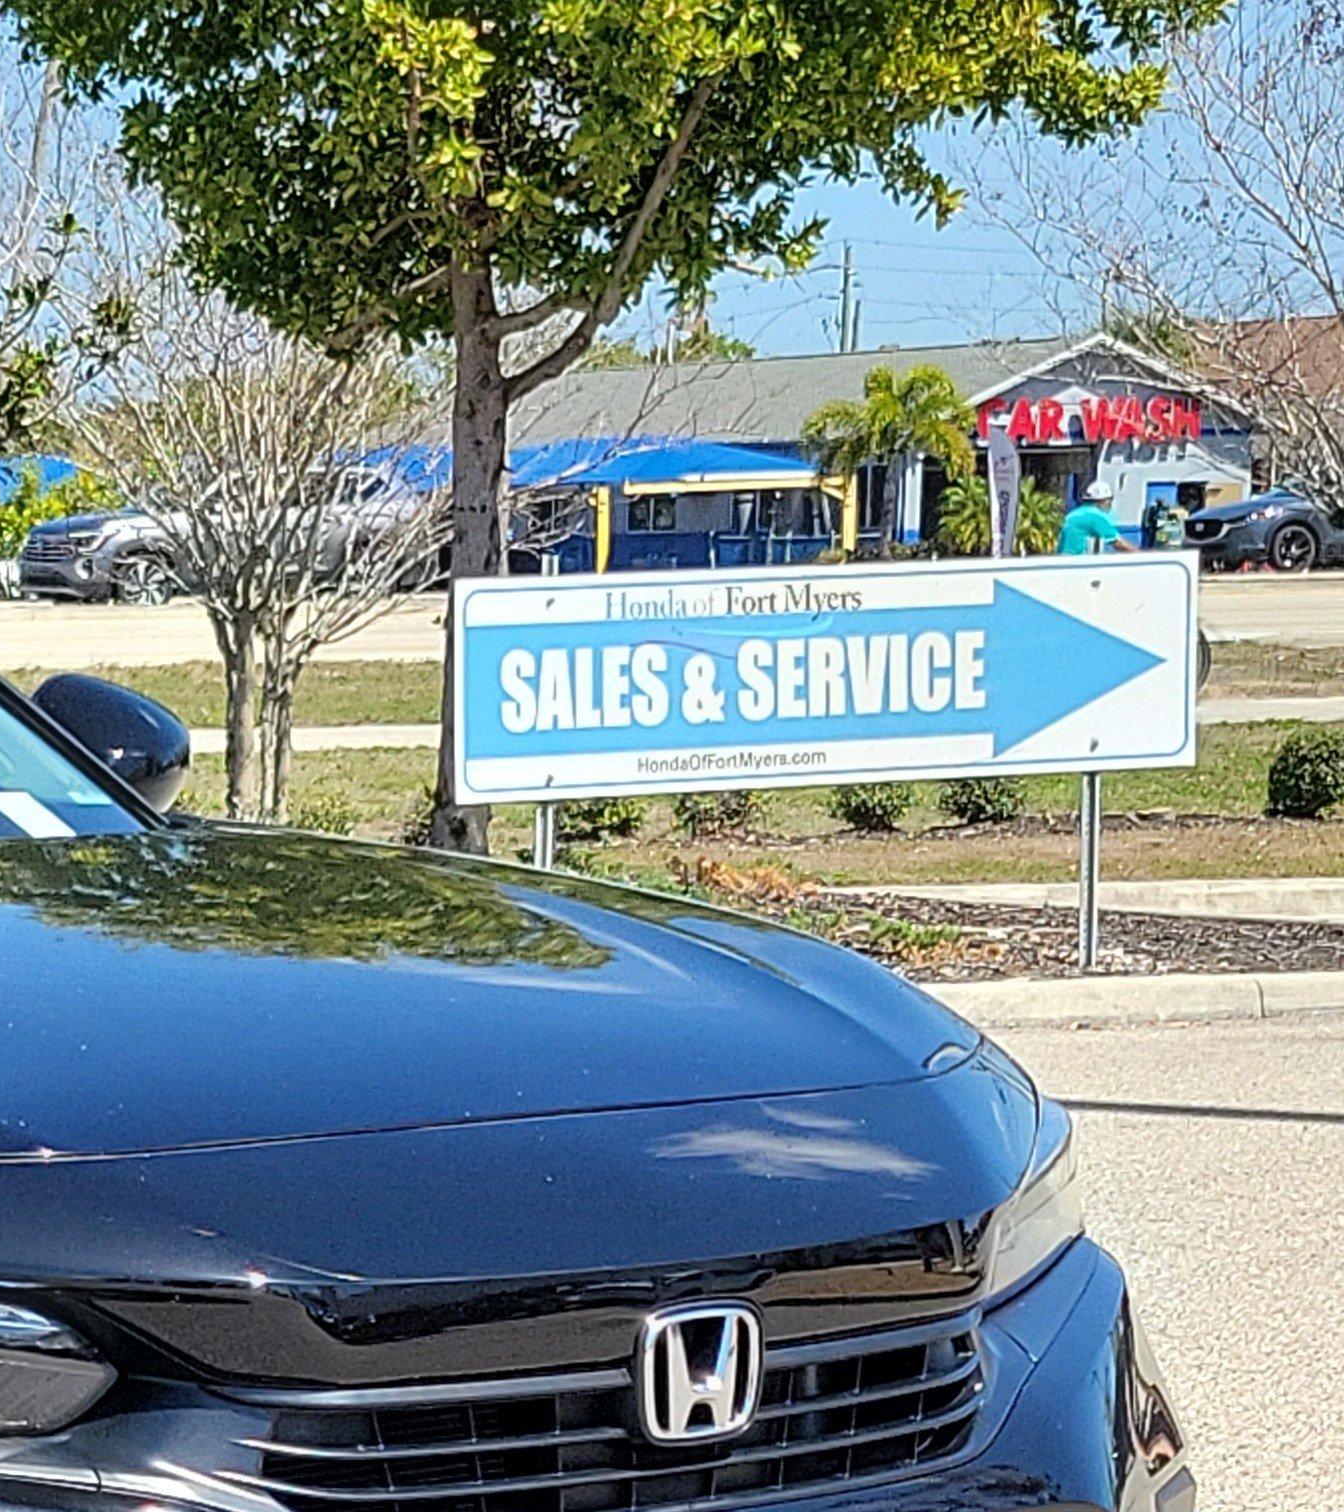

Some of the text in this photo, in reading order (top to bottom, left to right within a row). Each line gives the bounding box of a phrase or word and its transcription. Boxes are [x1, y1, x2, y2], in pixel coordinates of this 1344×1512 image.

[1080, 395, 1201, 443] WASH
[605, 583, 863, 621] Honda of Fort Myers
[500, 630, 986, 734] SALES & SERVICE
[637, 751, 827, 774] HondaOfFortMyers.com
